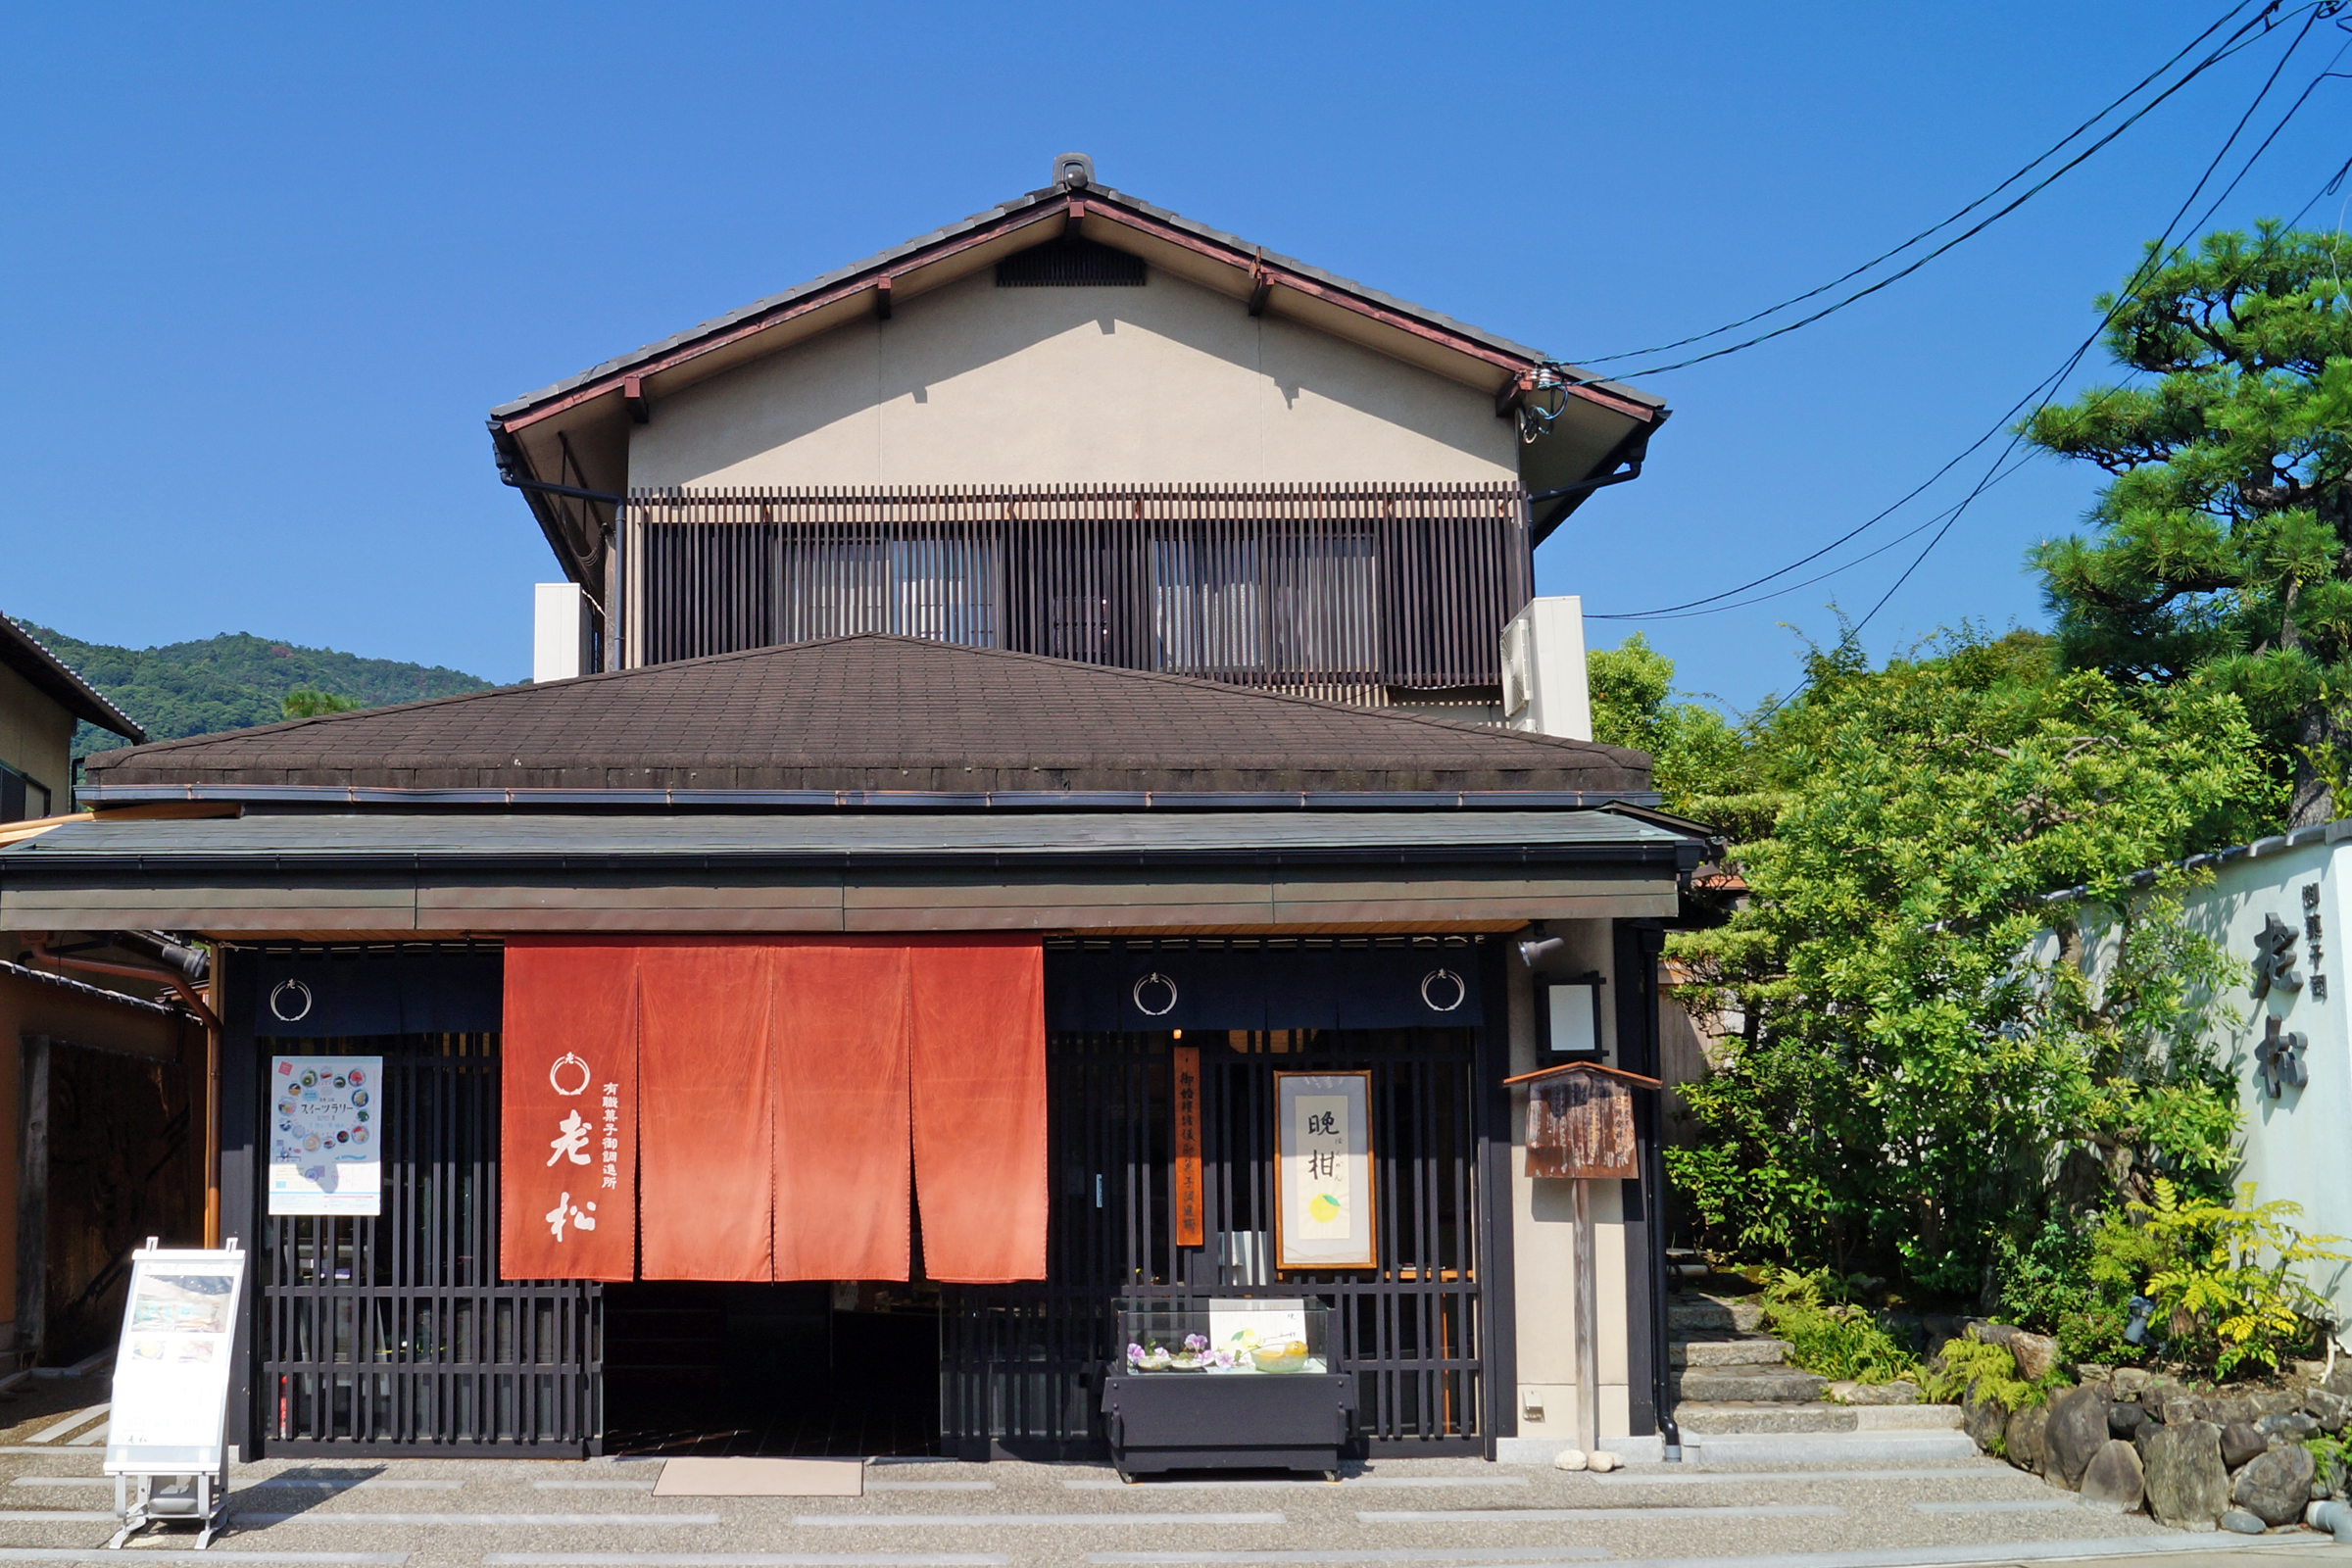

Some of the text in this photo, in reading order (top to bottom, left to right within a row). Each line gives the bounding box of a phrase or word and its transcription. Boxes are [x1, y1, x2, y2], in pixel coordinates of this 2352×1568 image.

[2302, 882, 2328, 1000] 御菓子司
[2251, 911, 2309, 1099] 老松
[301, 1103, 354, 1114] スイーツラリー
[601, 1082, 618, 1190] 有職菓子御調進所
[1307, 1110, 1341, 1180] 晩柑
[545, 1109, 597, 1243] 老松
